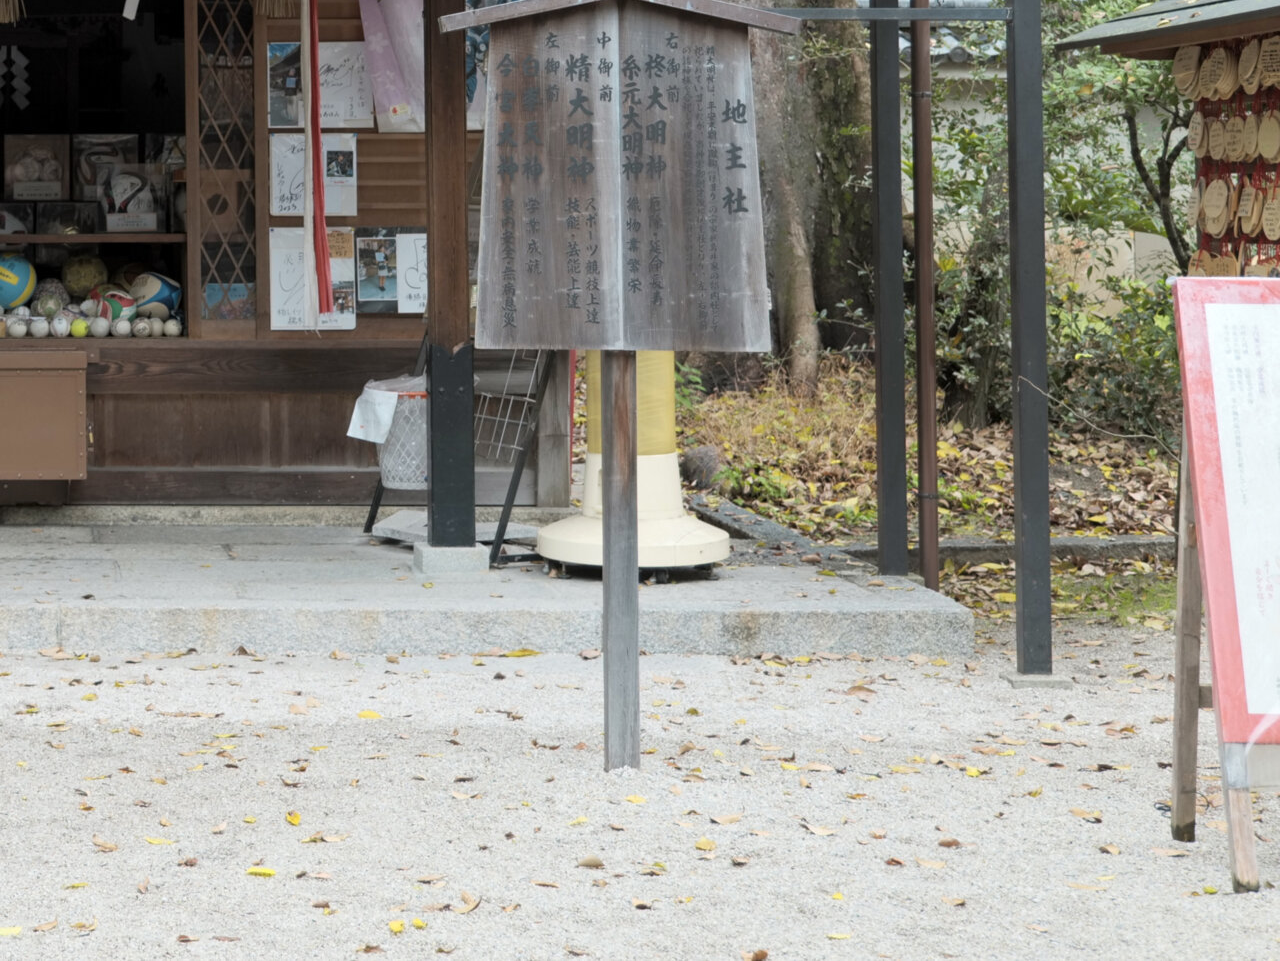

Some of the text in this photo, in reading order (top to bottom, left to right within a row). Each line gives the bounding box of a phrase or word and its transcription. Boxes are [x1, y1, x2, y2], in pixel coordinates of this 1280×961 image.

[496, 54, 518, 182] 今宮大神
[522, 55, 543, 182] 白峯天神
[544, 32, 560, 103] 左御前
[565, 54, 594, 184] 精大明神
[597, 31, 613, 103] 中御前
[645, 55, 667, 179] 柊大明神
[665, 32, 681, 103] 右御前
[622, 55, 644, 293] 糸元大明神 織物業繁栄
[722, 99, 749, 214] 地主社
[566, 197, 581, 309] 技能・芸能上達
